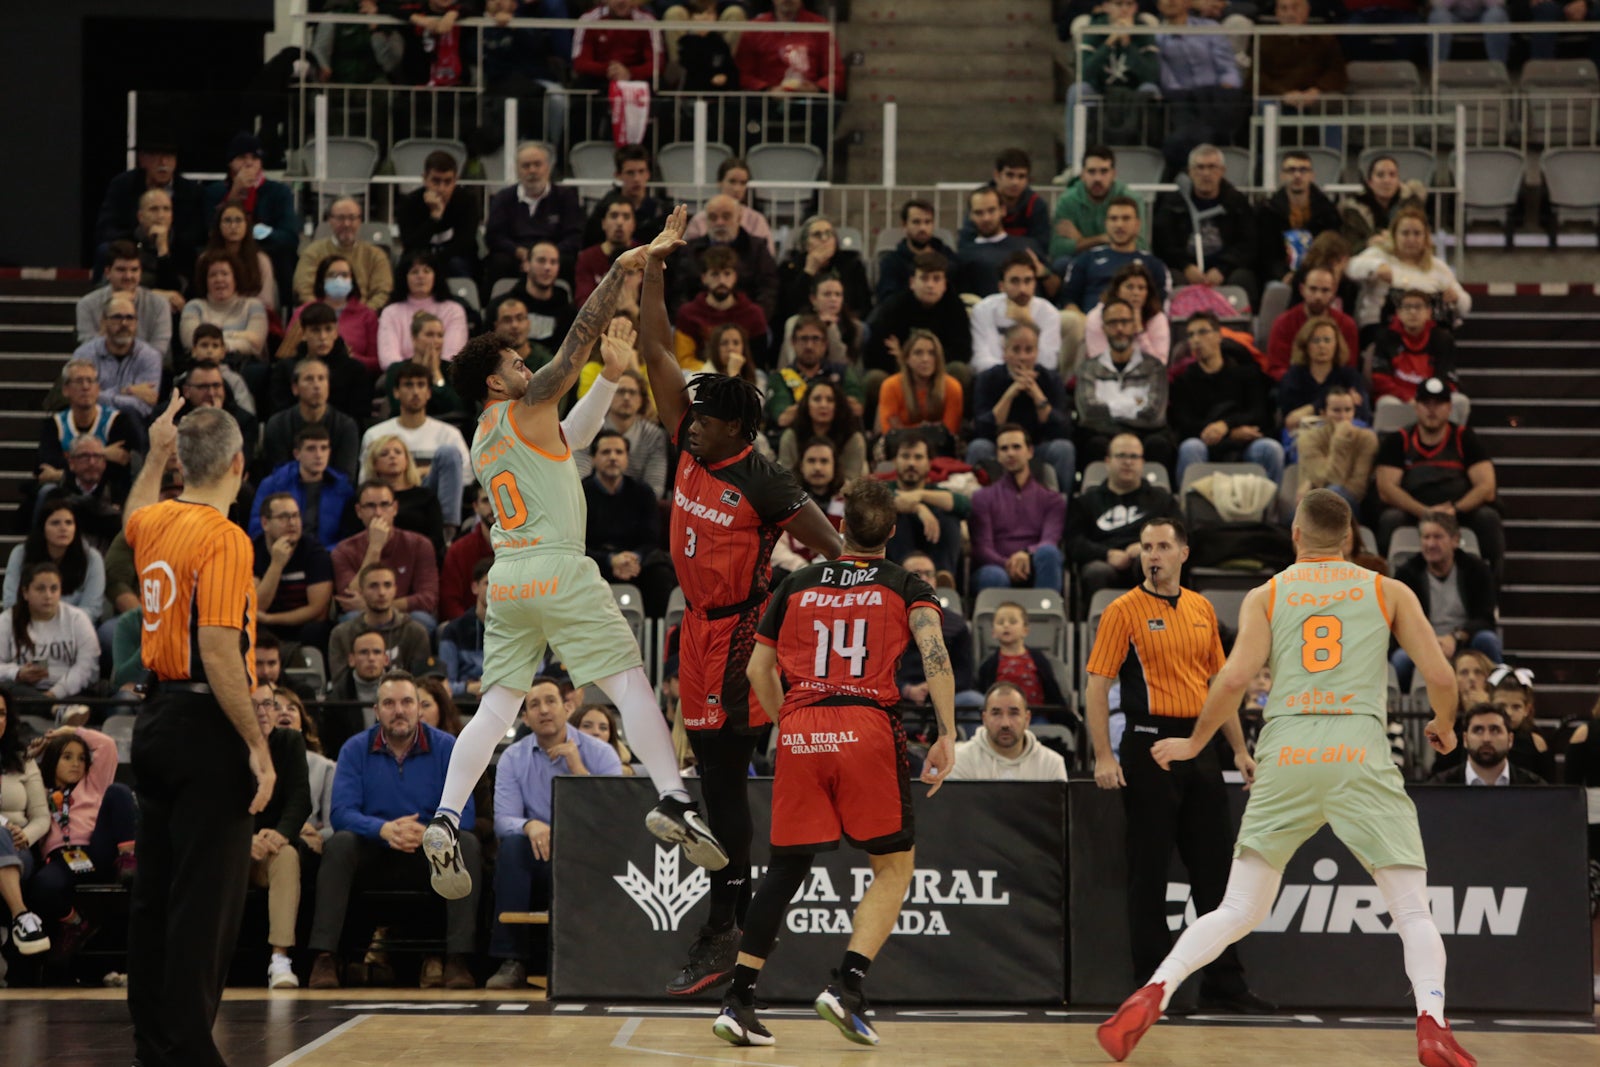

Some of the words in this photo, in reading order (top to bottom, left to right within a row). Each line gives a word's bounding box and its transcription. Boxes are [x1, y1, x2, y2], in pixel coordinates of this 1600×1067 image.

[490, 470, 528, 530] 0
[684, 527, 696, 557] 3
[144, 578, 160, 614] 60
[491, 576, 559, 602] Recalvi
[800, 591, 882, 607] PULEVA
[1287, 587, 1364, 607] CAZOO
[814, 619, 868, 677] 14
[1302, 615, 1342, 673] 8
[782, 733, 806, 746] CAJA
[810, 731, 858, 744] RURAL
[791, 744, 839, 754] GRANADA
[1277, 743, 1366, 767] Recalvi
[850, 867, 1009, 905] RRAL
[786, 908, 950, 936] GRADA
